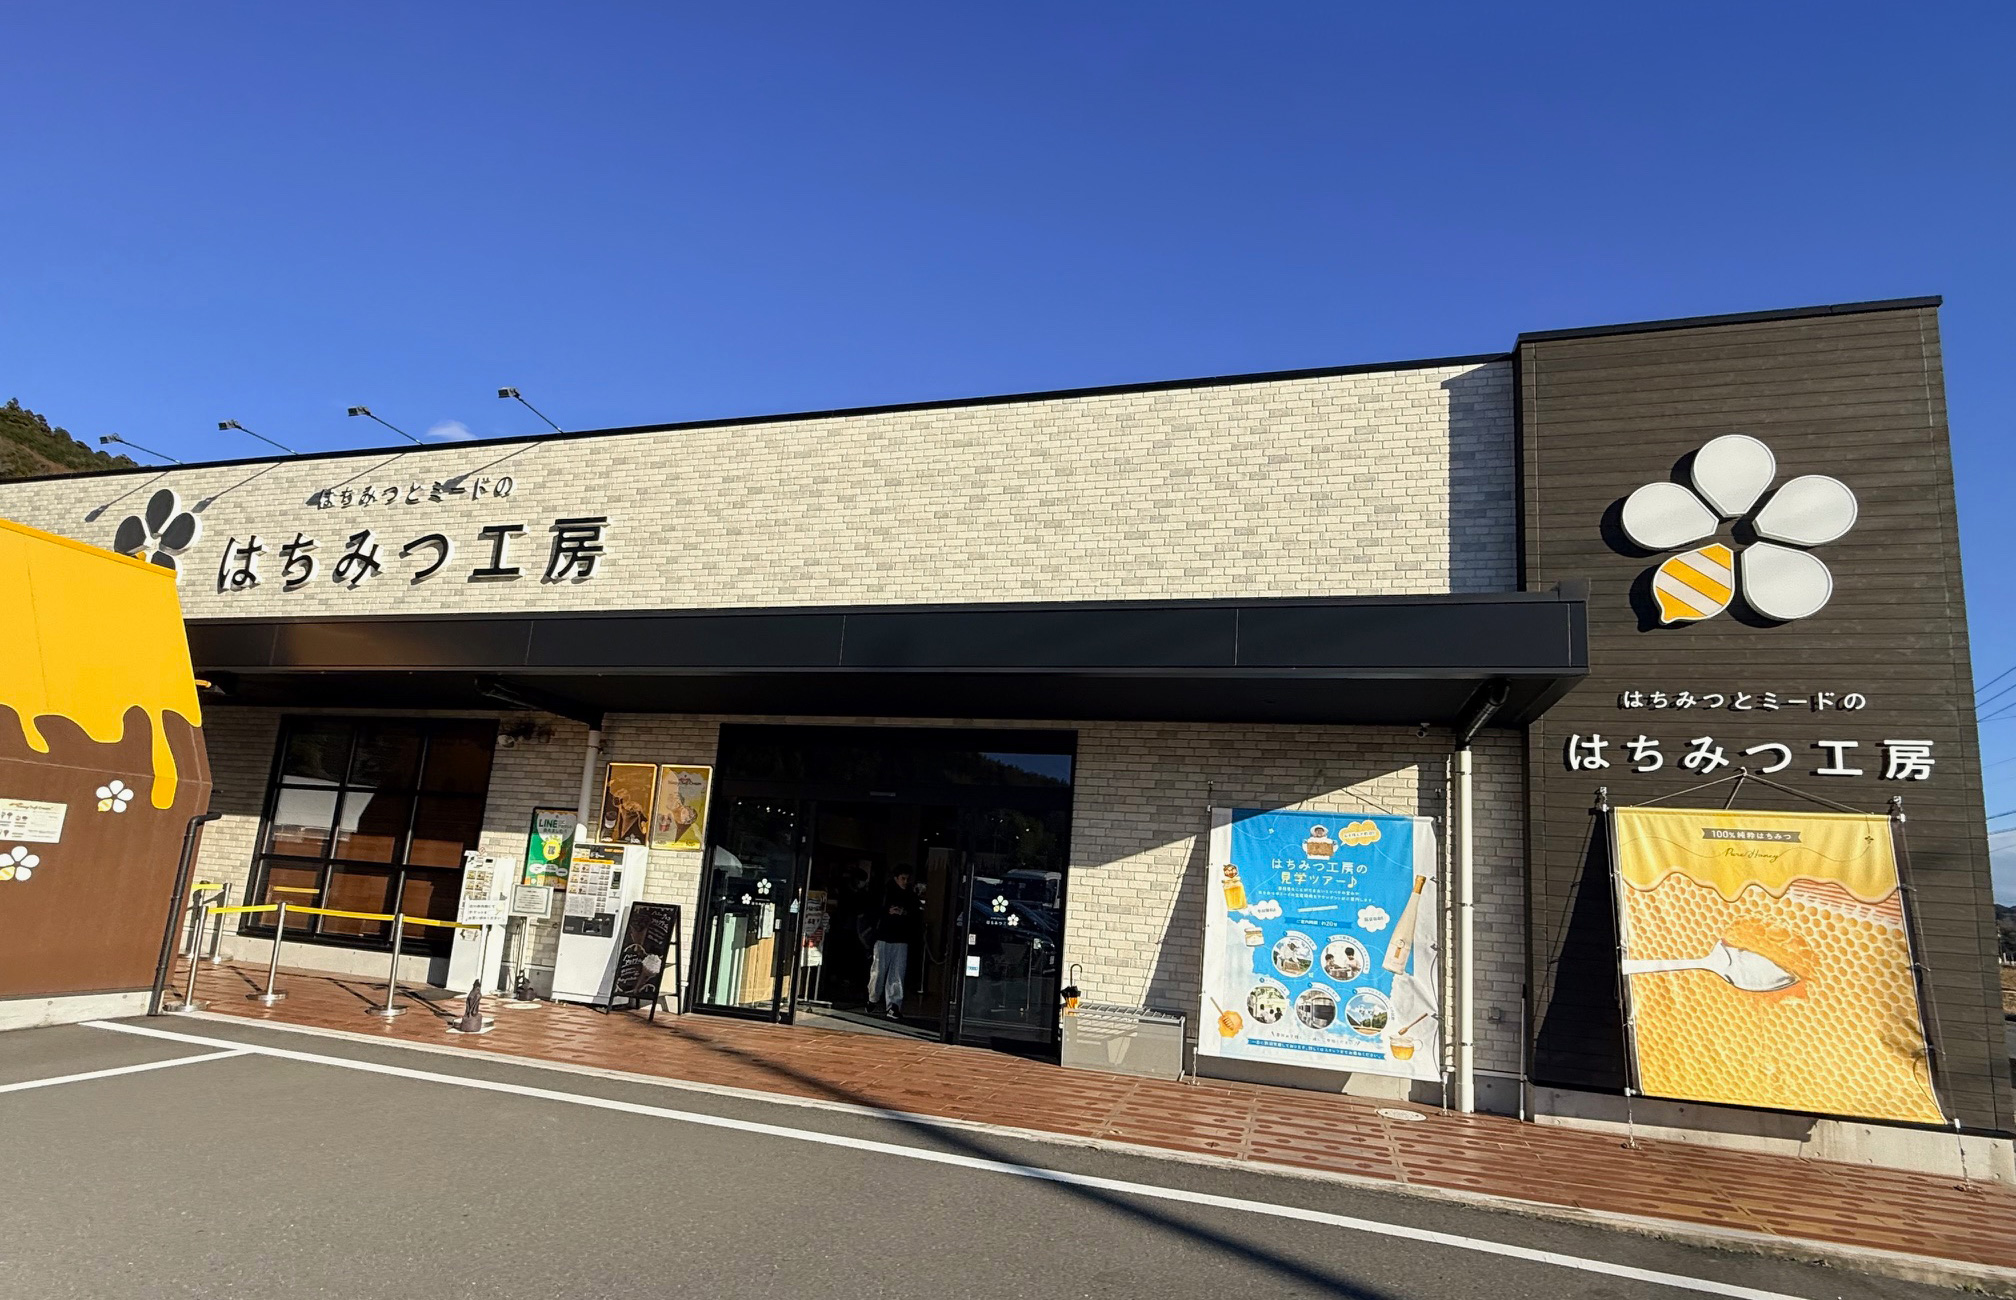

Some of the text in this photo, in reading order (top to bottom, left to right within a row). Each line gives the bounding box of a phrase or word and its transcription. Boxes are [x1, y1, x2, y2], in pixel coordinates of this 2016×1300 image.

[317, 476, 513, 509] はちみつとミードの
[217, 516, 609, 591] はちみつ工房
[1623, 690, 1866, 711] はちみつとミードの
[1569, 734, 1936, 780] はちみつ工房
[539, 818, 557, 828] LINE
[1271, 858, 1368, 875] はちみつ工房の
